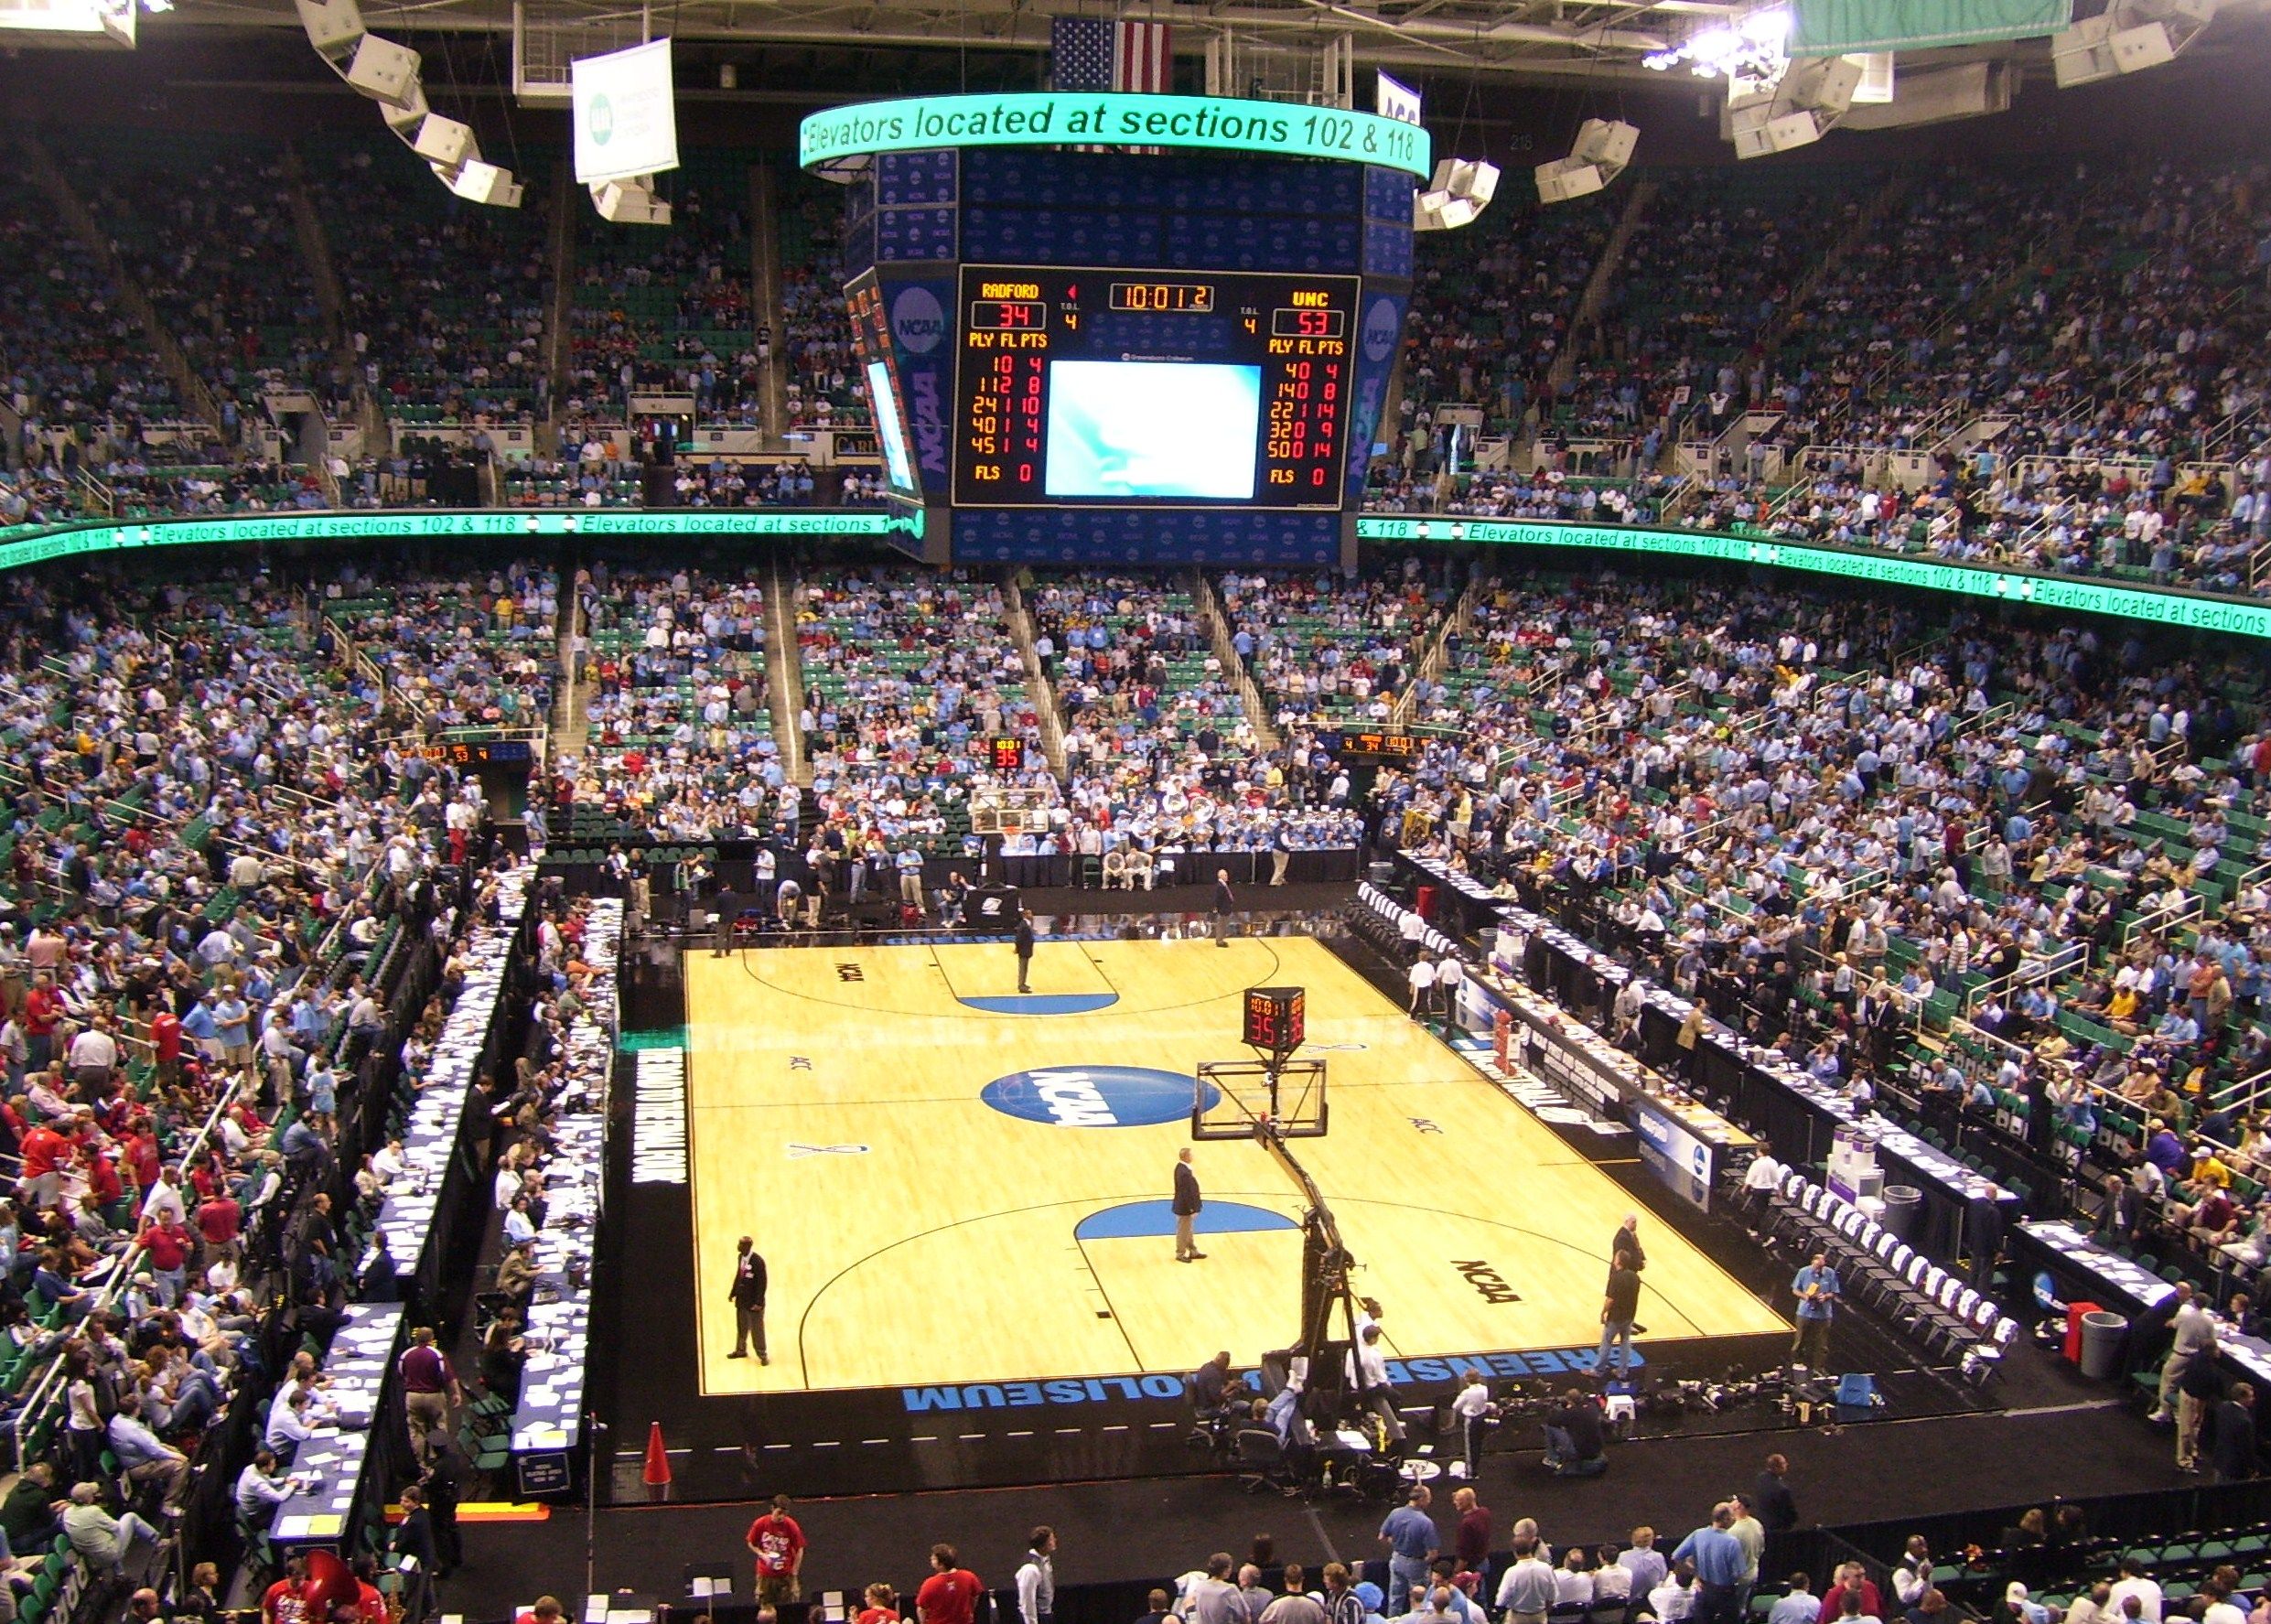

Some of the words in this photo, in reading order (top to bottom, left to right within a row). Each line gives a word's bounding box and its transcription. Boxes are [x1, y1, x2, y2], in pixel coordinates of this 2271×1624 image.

[809, 116, 903, 152] Elevators
[915, 102, 1055, 137] located
[1067, 102, 1106, 134] at
[1119, 106, 1288, 144] sections
[1304, 115, 1353, 149] 102
[1362, 124, 1377, 153] &
[1387, 128, 1415, 162] 118
[983, 283, 1039, 299] RADFORD
[1194, 286, 1206, 305] 2
[1293, 291, 1329, 307] UNC
[1000, 304, 1028, 328] 34
[1065, 314, 1077, 329] 4
[1299, 312, 1328, 335] 53
[1244, 318, 1255, 334] 4
[970, 332, 994, 347] PLY
[1001, 333, 1017, 348] FL
[1021, 333, 1048, 348] PTS
[1269, 339, 1293, 353] PLY
[1299, 339, 1314, 354] FL
[1318, 340, 1343, 355] PTS
[1001, 355, 1012, 373] 0
[1029, 357, 1041, 373] 4
[1286, 362, 1297, 378] 4
[1298, 361, 1310, 380] 0
[1327, 363, 1338, 379] 4
[1000, 376, 1012, 393] 2
[1028, 376, 1040, 394] 8
[1279, 382, 1295, 397] 14
[1297, 382, 1308, 400] 0
[1324, 382, 1336, 401] 8
[973, 395, 997, 414] 24
[1006, 397, 1011, 414] 1
[1022, 396, 1039, 414] 10
[1270, 401, 1294, 419] 22
[1301, 403, 1308, 418] 1
[1317, 403, 1334, 419] 14
[912, 371, 946, 474] NCAA
[973, 416, 996, 434] 40
[1005, 417, 1010, 433] 1
[1027, 417, 1039, 434] 4
[1270, 421, 1292, 438] 32
[1294, 421, 1306, 439] 0
[1321, 421, 1332, 438] 9
[972, 436, 996, 454] 45
[1004, 437, 1009, 453] 1
[1026, 437, 1039, 453] 4
[1268, 440, 1290, 458] 50
[1292, 440, 1304, 458] 0
[1314, 442, 1331, 457] 14
[975, 465, 1000, 479] FLS
[1019, 464, 1031, 482] 0
[1270, 468, 1294, 484] FLS
[1312, 468, 1324, 486] 0
[153, 524, 226, 543] Elevators
[232, 520, 299, 539] located
[305, 519, 321, 535] at
[329, 518, 412, 534] sections
[422, 516, 454, 532] 102
[461, 517, 474, 532] &
[484, 515, 516, 531] 118
[583, 516, 677, 532] Elevators
[683, 516, 757, 532] located
[763, 517, 782, 532] at
[791, 517, 871, 532] sections
[1357, 522, 1369, 536] &
[1376, 522, 1407, 536] 118
[1469, 523, 1553, 543] Elevators
[1558, 527, 1618, 546] located
[1622, 533, 1638, 548] at
[1641, 534, 1696, 553] sections
[1701, 538, 1722, 556] 102
[1778, 547, 1823, 569] Elevators
[1826, 552, 1865, 574] located
[1867, 560, 1878, 576] at
[1880, 562, 1928, 586] sections
[1932, 566, 1954, 588] 102
[1956, 571, 1965, 590] &
[1970, 572, 1991, 594] 118
[2034, 580, 2102, 609] Elevators
[2105, 588, 2165, 618] located
[2170, 601, 2187, 622] at
[2191, 605, 2266, 634] sections
[456, 751, 468, 762] 53
[479, 750, 488, 760] 4
[997, 749, 1017, 767] 35
[834, 963, 865, 982] NCAA
[1251, 1014, 1275, 1044] 35
[1028, 1071, 1119, 1126] NCAA
[1406, 1117, 1444, 1135] ACC
[1449, 1260, 1523, 1305] NCAA
[901, 1373, 1195, 1412] OLISEUM
